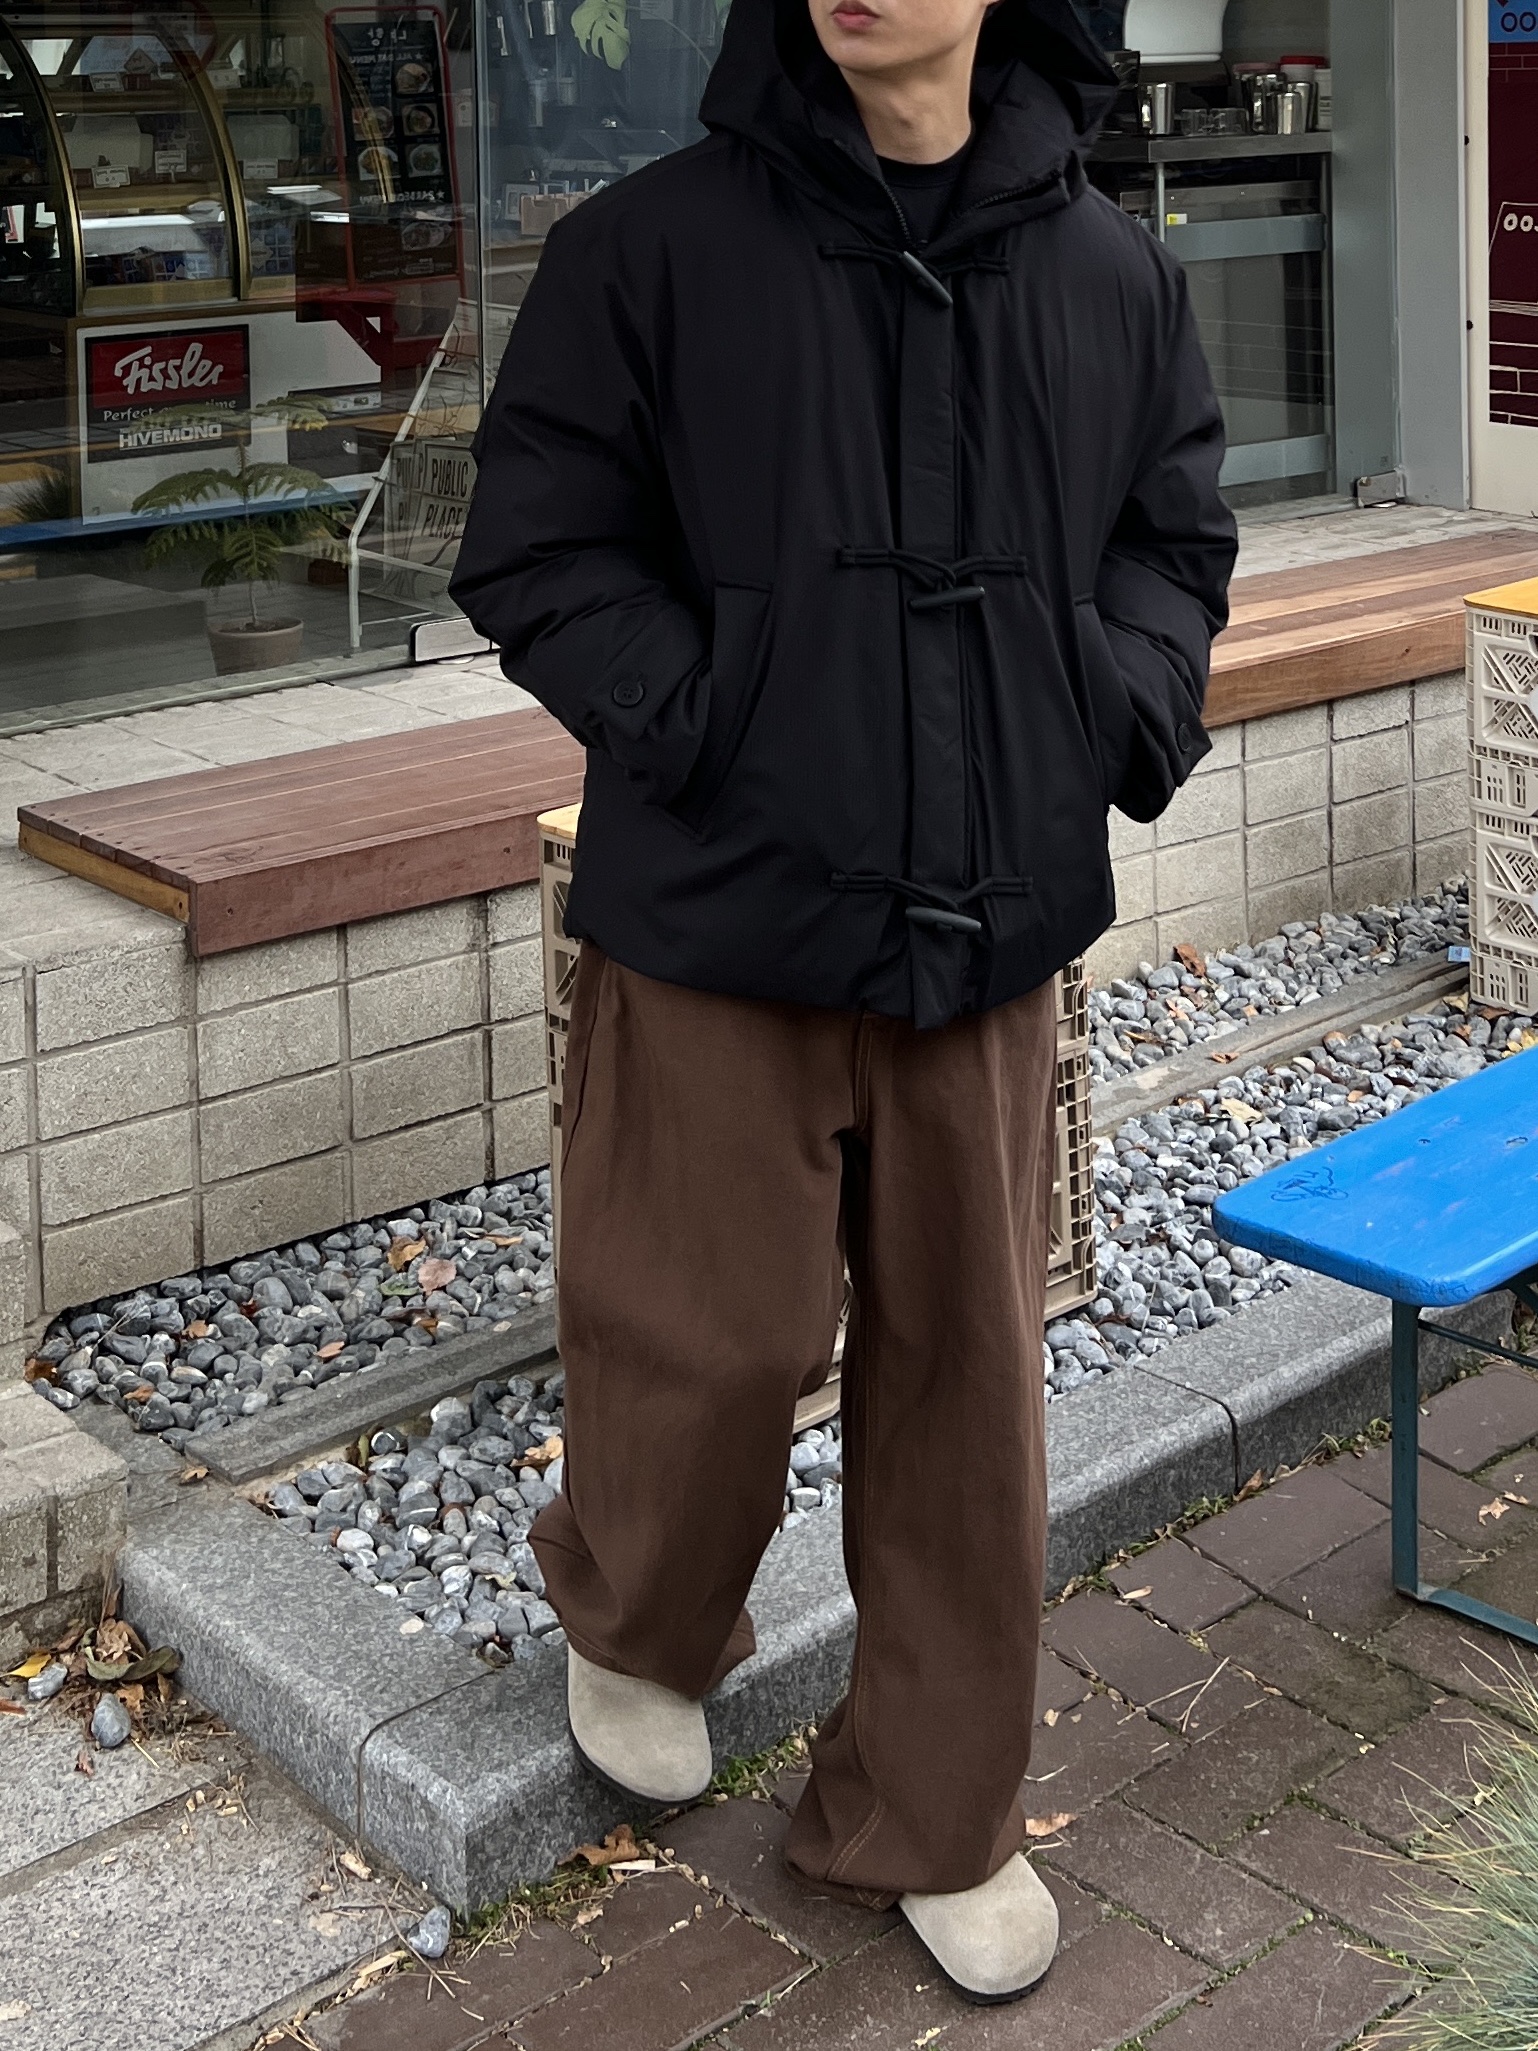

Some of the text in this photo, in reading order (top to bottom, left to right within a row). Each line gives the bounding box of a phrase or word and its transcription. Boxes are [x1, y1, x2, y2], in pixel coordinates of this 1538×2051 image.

[114, 342, 224, 395] Fissler
[103, 407, 154, 422] Perfect
[119, 423, 222, 448] HIVEMONO
[431, 458, 469, 498] PUBLIC
